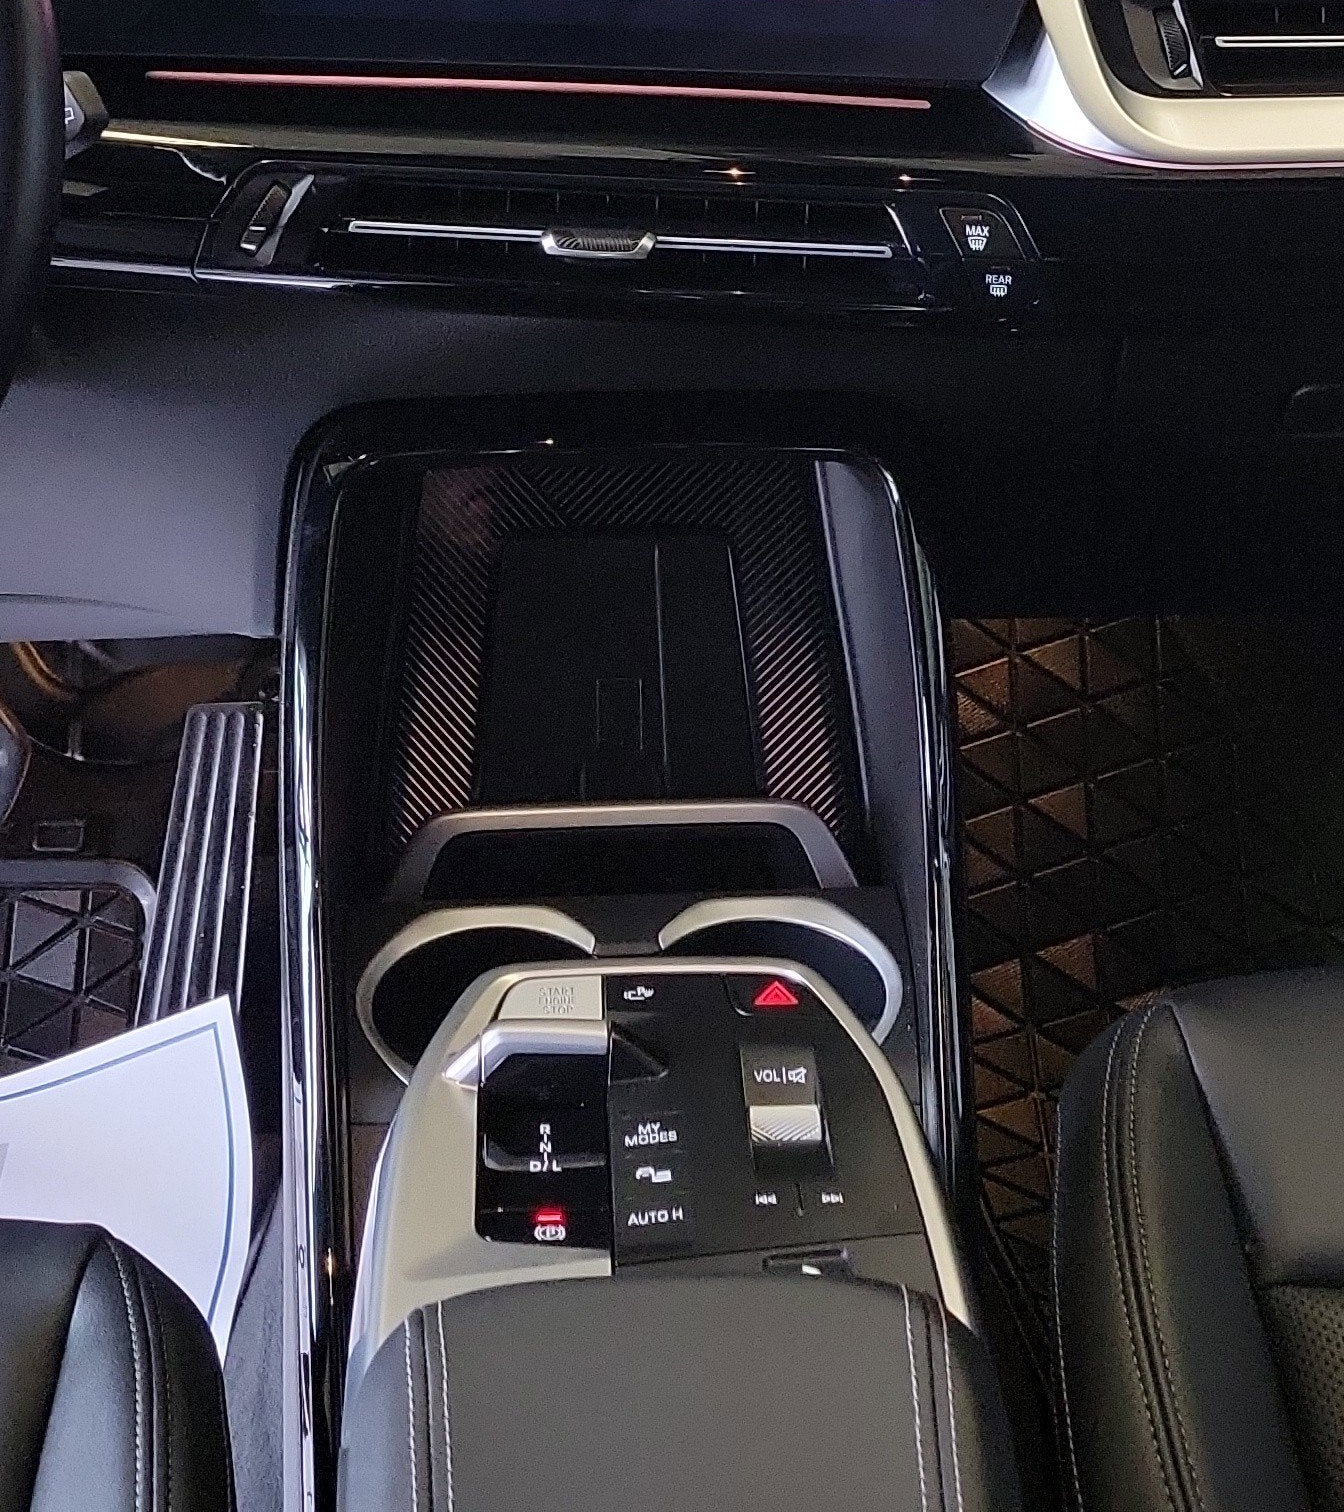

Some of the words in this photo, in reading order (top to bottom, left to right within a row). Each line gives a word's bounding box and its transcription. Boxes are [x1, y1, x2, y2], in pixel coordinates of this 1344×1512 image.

[965, 224, 990, 237] MAX
[985, 274, 1012, 285] REAR
[754, 1069, 780, 1083] VOL
[539, 1123, 551, 1135] R
[638, 1122, 661, 1135] MY
[624, 1130, 678, 1148] MODES
[539, 1141, 552, 1154] N
[627, 1209, 669, 1227] AUTO
[672, 1205, 684, 1221] H
